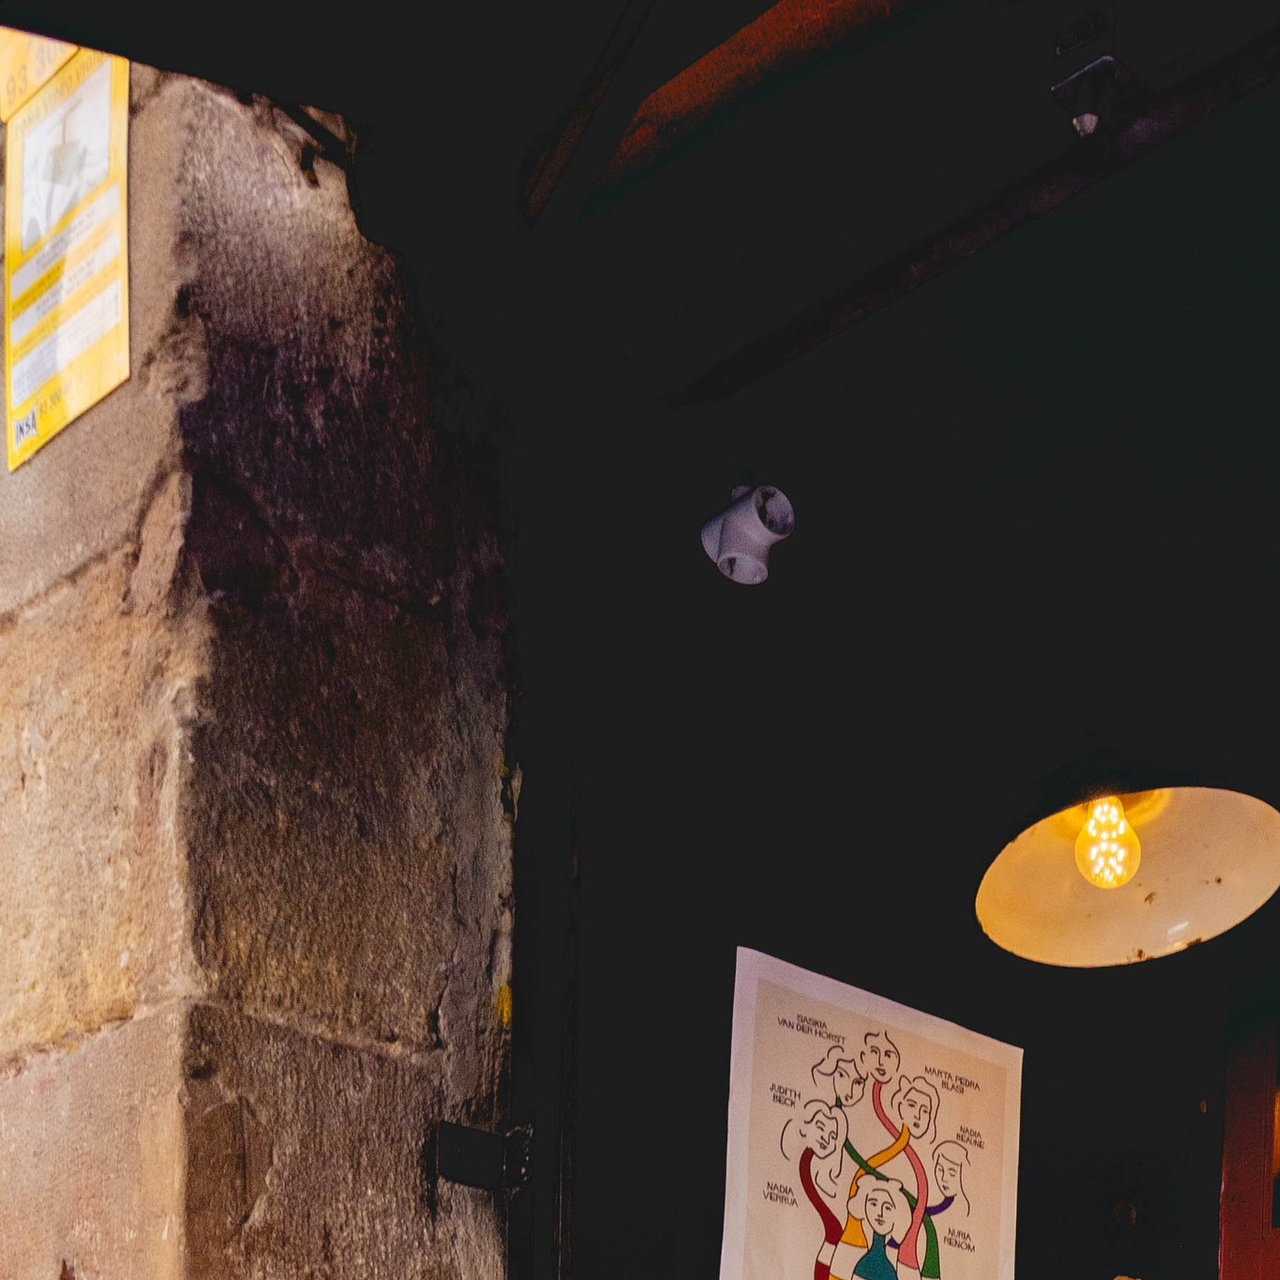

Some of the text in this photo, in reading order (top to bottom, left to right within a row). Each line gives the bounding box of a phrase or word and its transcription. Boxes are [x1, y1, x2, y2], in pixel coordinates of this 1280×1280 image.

[796, 1013, 828, 1030] SASKIA
[777, 1016, 846, 1045] VAN DER HORST
[925, 1065, 953, 1082] MARTA
[769, 1082, 801, 1101] JUDITH
[772, 1093, 796, 1109] BECK
[960, 1125, 982, 1140] NADIA
[767, 1181, 795, 1197] NADIA
